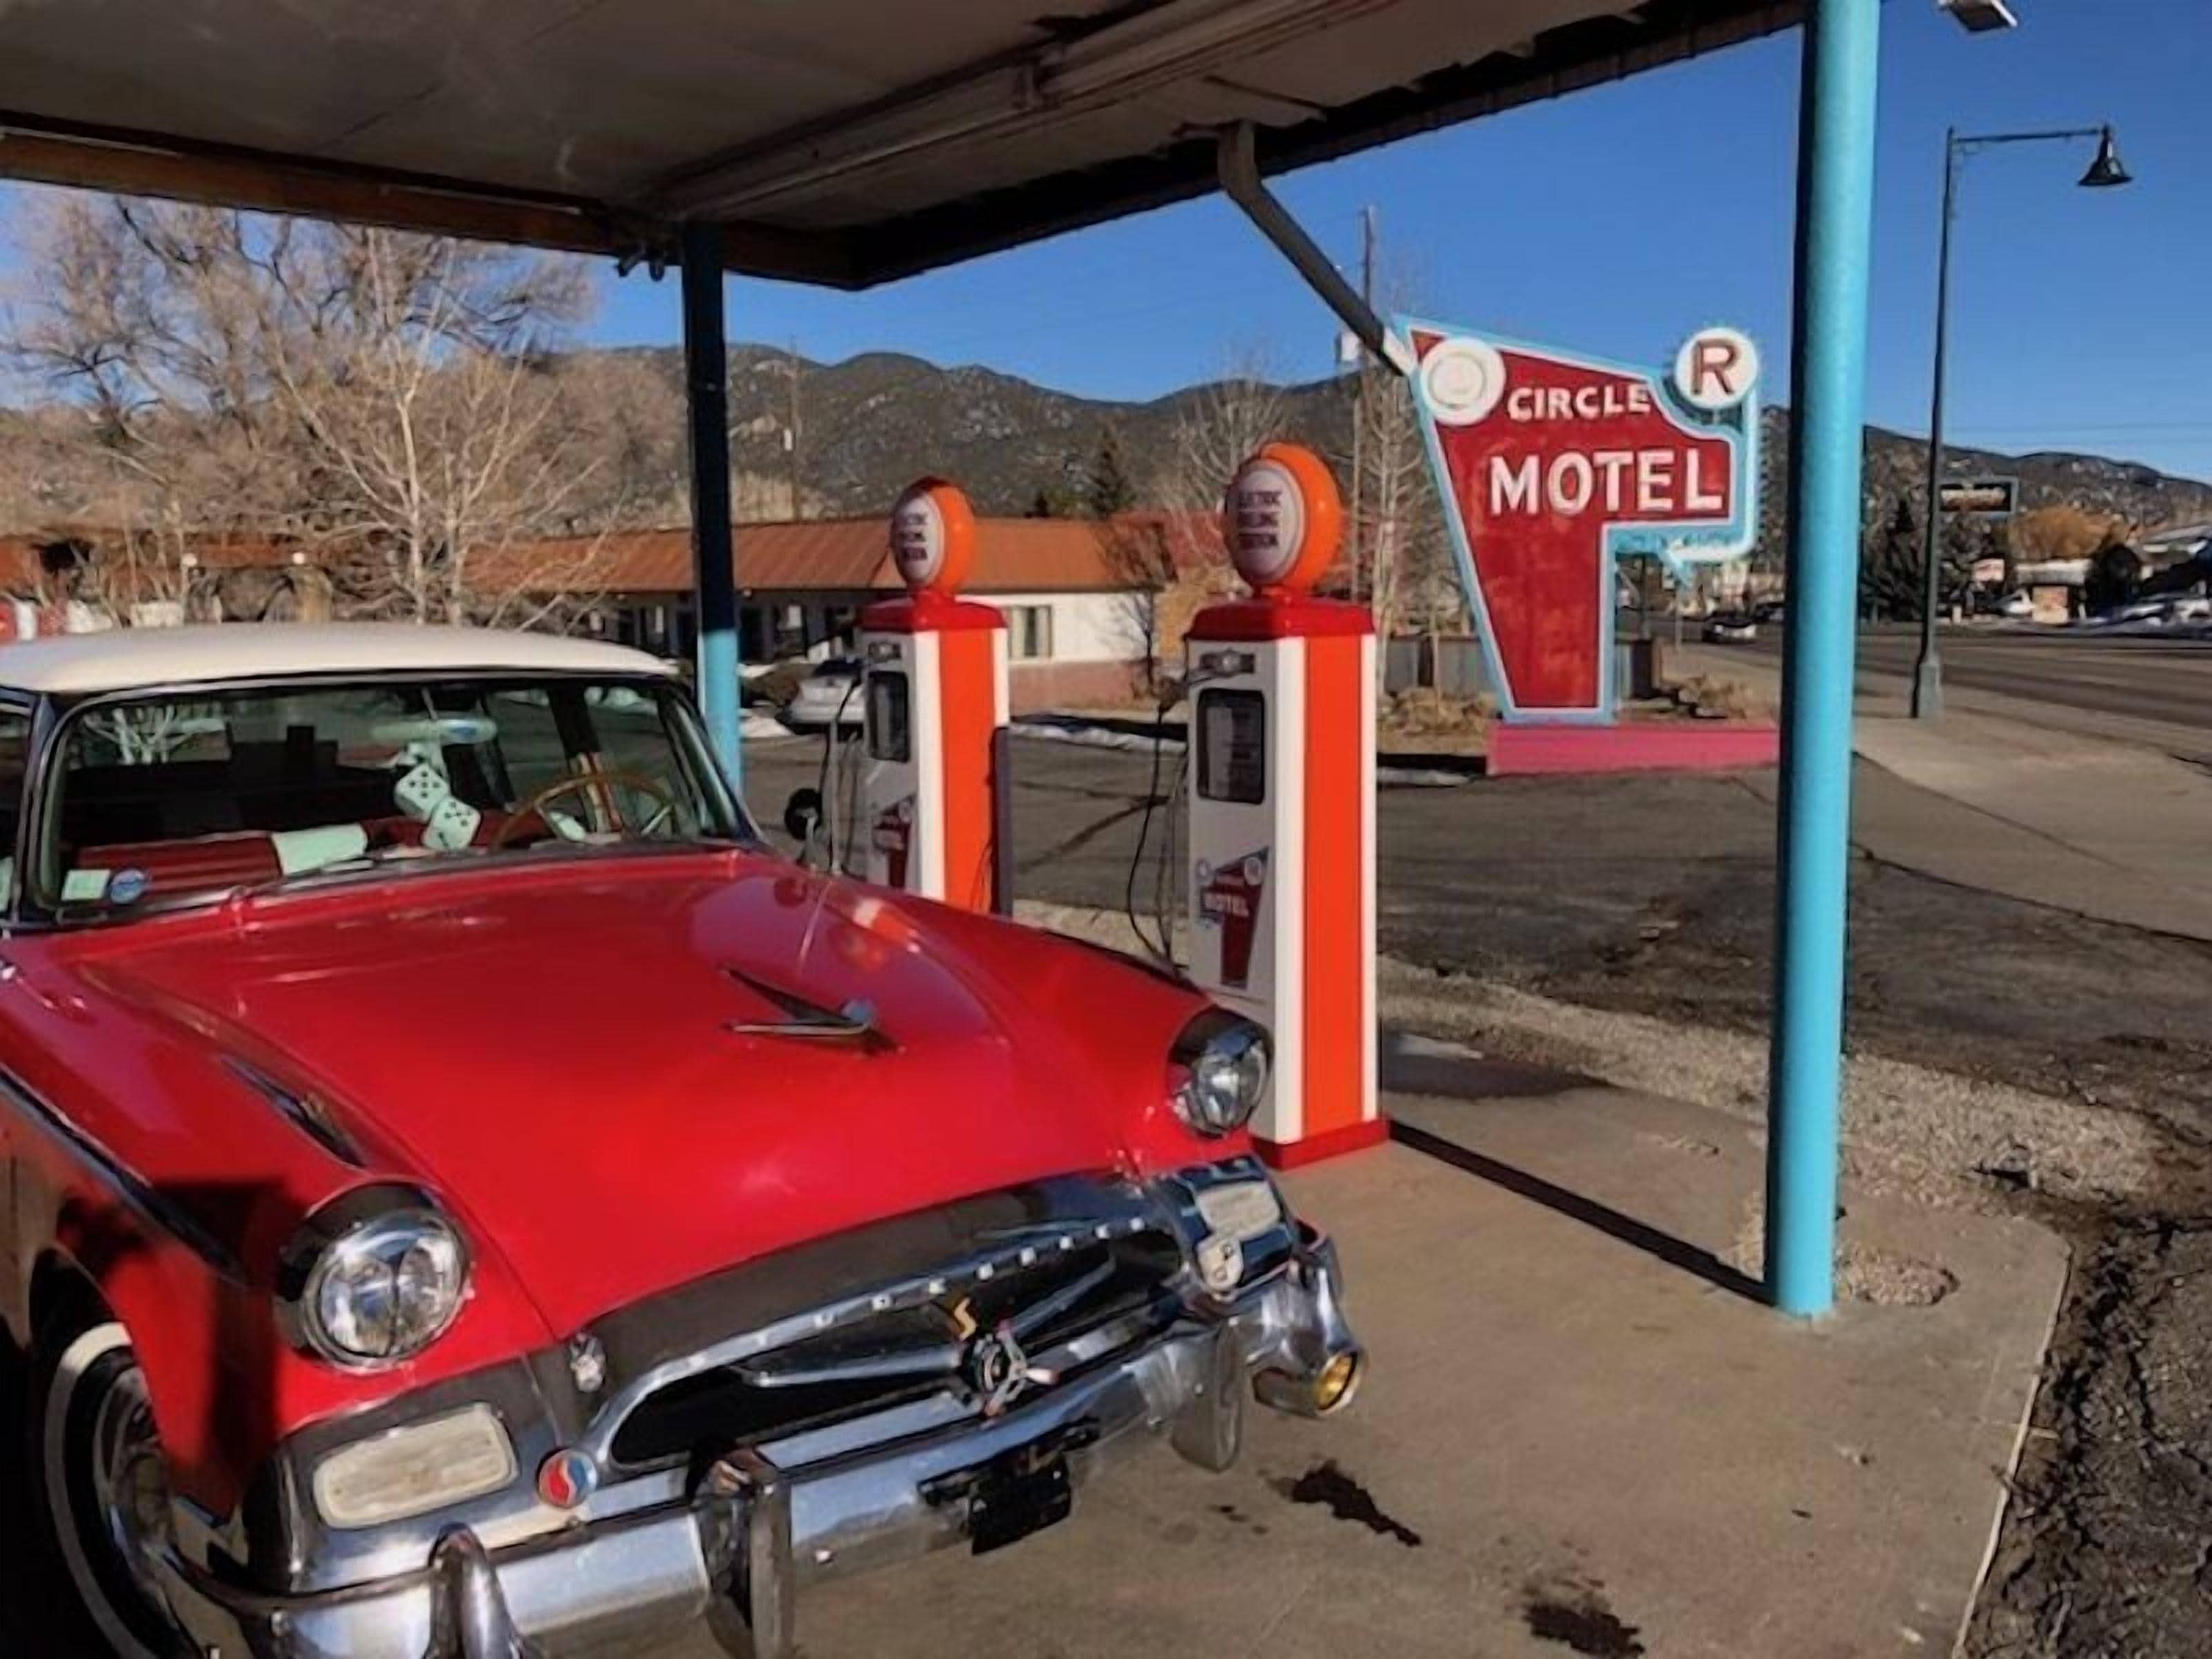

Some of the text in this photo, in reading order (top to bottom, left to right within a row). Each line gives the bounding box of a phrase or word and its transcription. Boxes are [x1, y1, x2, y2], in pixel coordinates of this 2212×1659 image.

[1507, 338, 1741, 421] CIRCLE R
[1489, 449, 1724, 516] MOTEL
